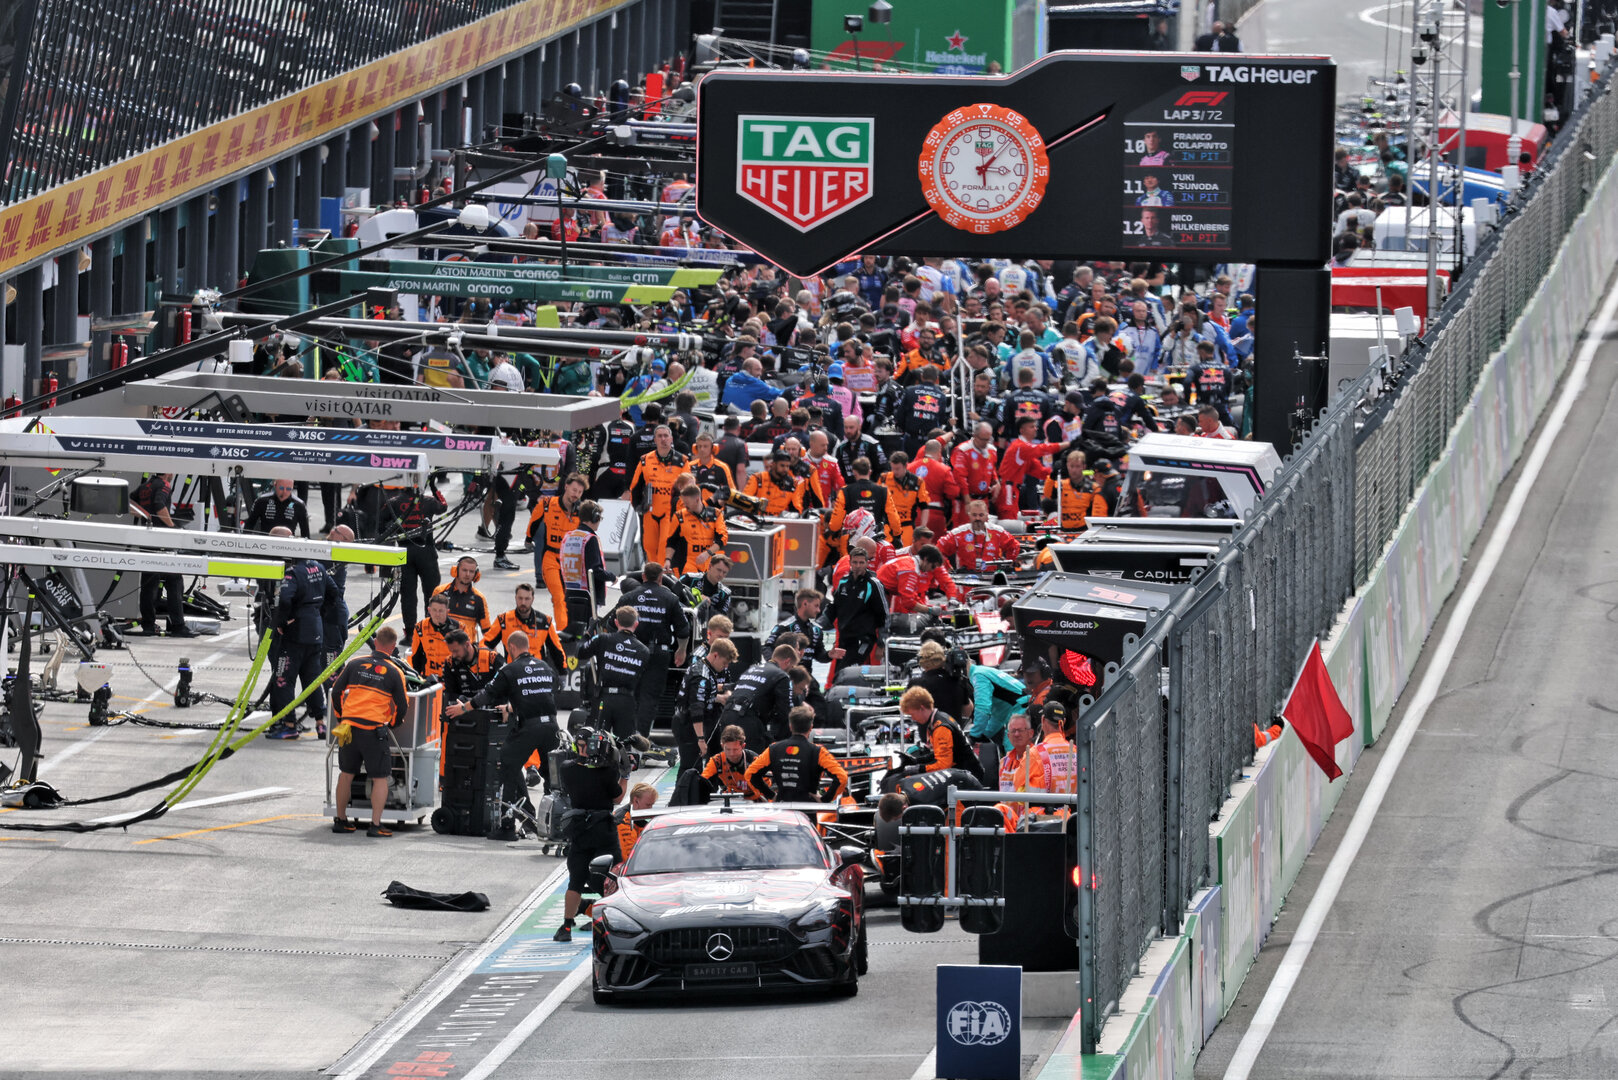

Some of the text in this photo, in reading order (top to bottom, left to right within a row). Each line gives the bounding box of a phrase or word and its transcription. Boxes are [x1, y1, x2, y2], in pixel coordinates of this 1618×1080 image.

[926, 50, 986, 64] Heineken
[1174, 91, 1229, 106] F1
[948, 110, 964, 124] 55
[1006, 112, 1022, 125] 05
[1164, 110, 1190, 120] LAP
[750, 125, 860, 158] TAG
[926, 130, 940, 146] 50
[1033, 134, 1042, 148] 10
[1173, 132, 1212, 140] FRANCO
[1124, 140, 1146, 154] 10
[1173, 142, 1228, 150] COLAPINTO
[1182, 152, 1220, 160] IN PIT
[920, 160, 928, 176] 45
[1038, 165, 1048, 176] 15
[1172, 174, 1194, 182] YUKI
[1124, 180, 1144, 194] 11
[1172, 182, 1219, 190] TSUNODA
[746, 168, 864, 222] HEUER
[925, 189, 936, 204] 40
[1028, 192, 1040, 208] 20
[1181, 193, 1218, 202] IN PIT
[945, 212, 959, 226] 35
[1004, 214, 1020, 228] 25
[974, 224, 990, 232] 30
[1123, 221, 1144, 234] 12
[1171, 223, 1230, 232] HULKENBERG
[1180, 233, 1218, 242] IN PIT
[435, 266, 560, 280] ASTON MARTIN aramco
[632, 272, 659, 282] arm
[388, 280, 514, 295] ASTON MARTIN aramco
[586, 289, 613, 300] arm
[298, 430, 326, 441] MSC
[456, 440, 486, 450] BWT
[221, 448, 250, 458] MSC
[382, 457, 412, 468] BWT
[211, 540, 268, 550] CADILLAC
[73, 556, 136, 566] CADILLAC
[46, 580, 68, 606] QATAR
[57, 582, 73, 602] visit
[1060, 620, 1093, 628] Globant
[604, 651, 642, 666] PETRONAS
[693, 966, 748, 976] SAFETY CAR
